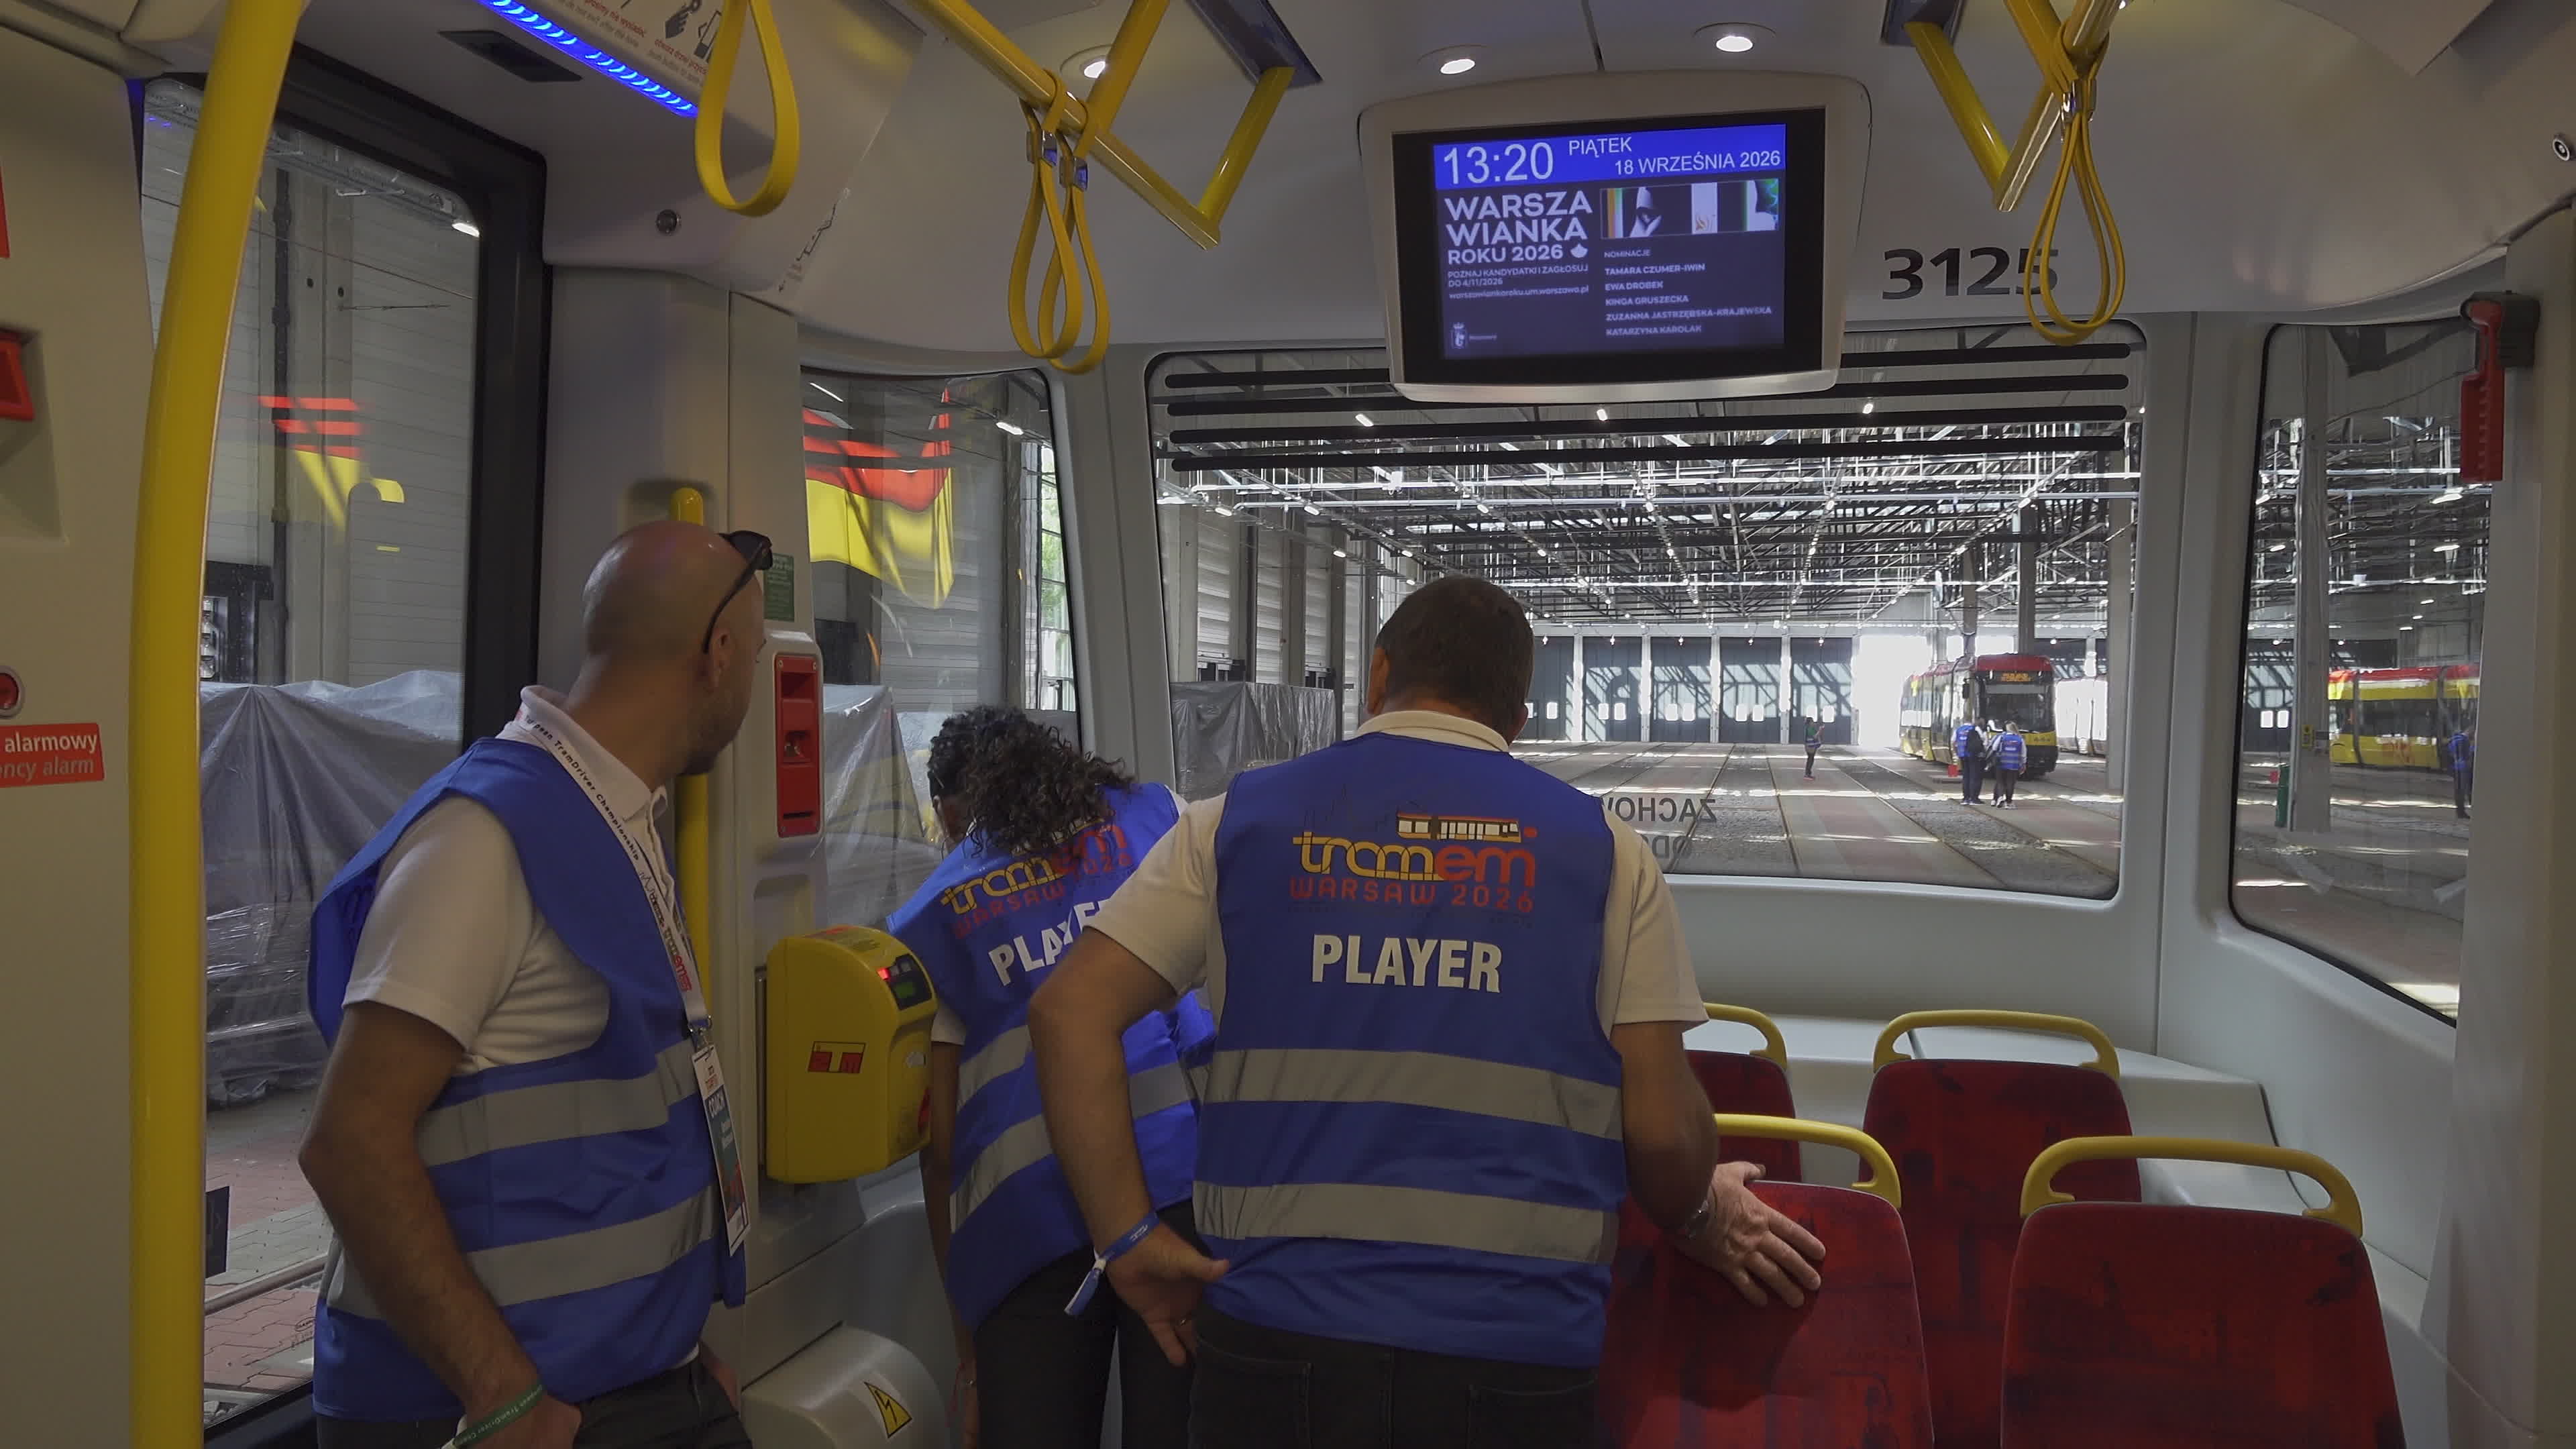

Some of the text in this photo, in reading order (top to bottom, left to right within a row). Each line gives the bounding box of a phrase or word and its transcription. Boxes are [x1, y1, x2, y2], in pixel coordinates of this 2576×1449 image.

[1568, 137, 1632, 158] PIĄTEK
[1444, 142, 1554, 185] 13:20
[1615, 150, 1781, 176] 18 WRZEŚNIA 2026
[1444, 190, 1594, 221] WARSZA
[1446, 217, 1589, 247] WIANKA
[1448, 244, 1564, 265] ROKU 2026
[1604, 250, 1651, 258] NOMINACJE
[1448, 270, 1483, 279] POZNAJ
[1483, 267, 1537, 277] KANDYDATKI
[1542, 264, 1589, 274] ZAGŁOSUJ
[1448, 279, 1462, 288] DO
[1605, 267, 1642, 276] TAMARA
[1881, 246, 2059, 301] 3125
[1605, 282, 1625, 291] EWA
[1605, 295, 1689, 307] KINGA GRUSZECKA
[5, 731, 97, 754] alarmowy
[0, 755, 94, 783] ncy alarm
[596, 794, 640, 861] Championship
[1290, 876, 1535, 913] WARSAW 2026
[987, 900, 1100, 986] PLAYE
[1311, 934, 1503, 994] PLAYER
